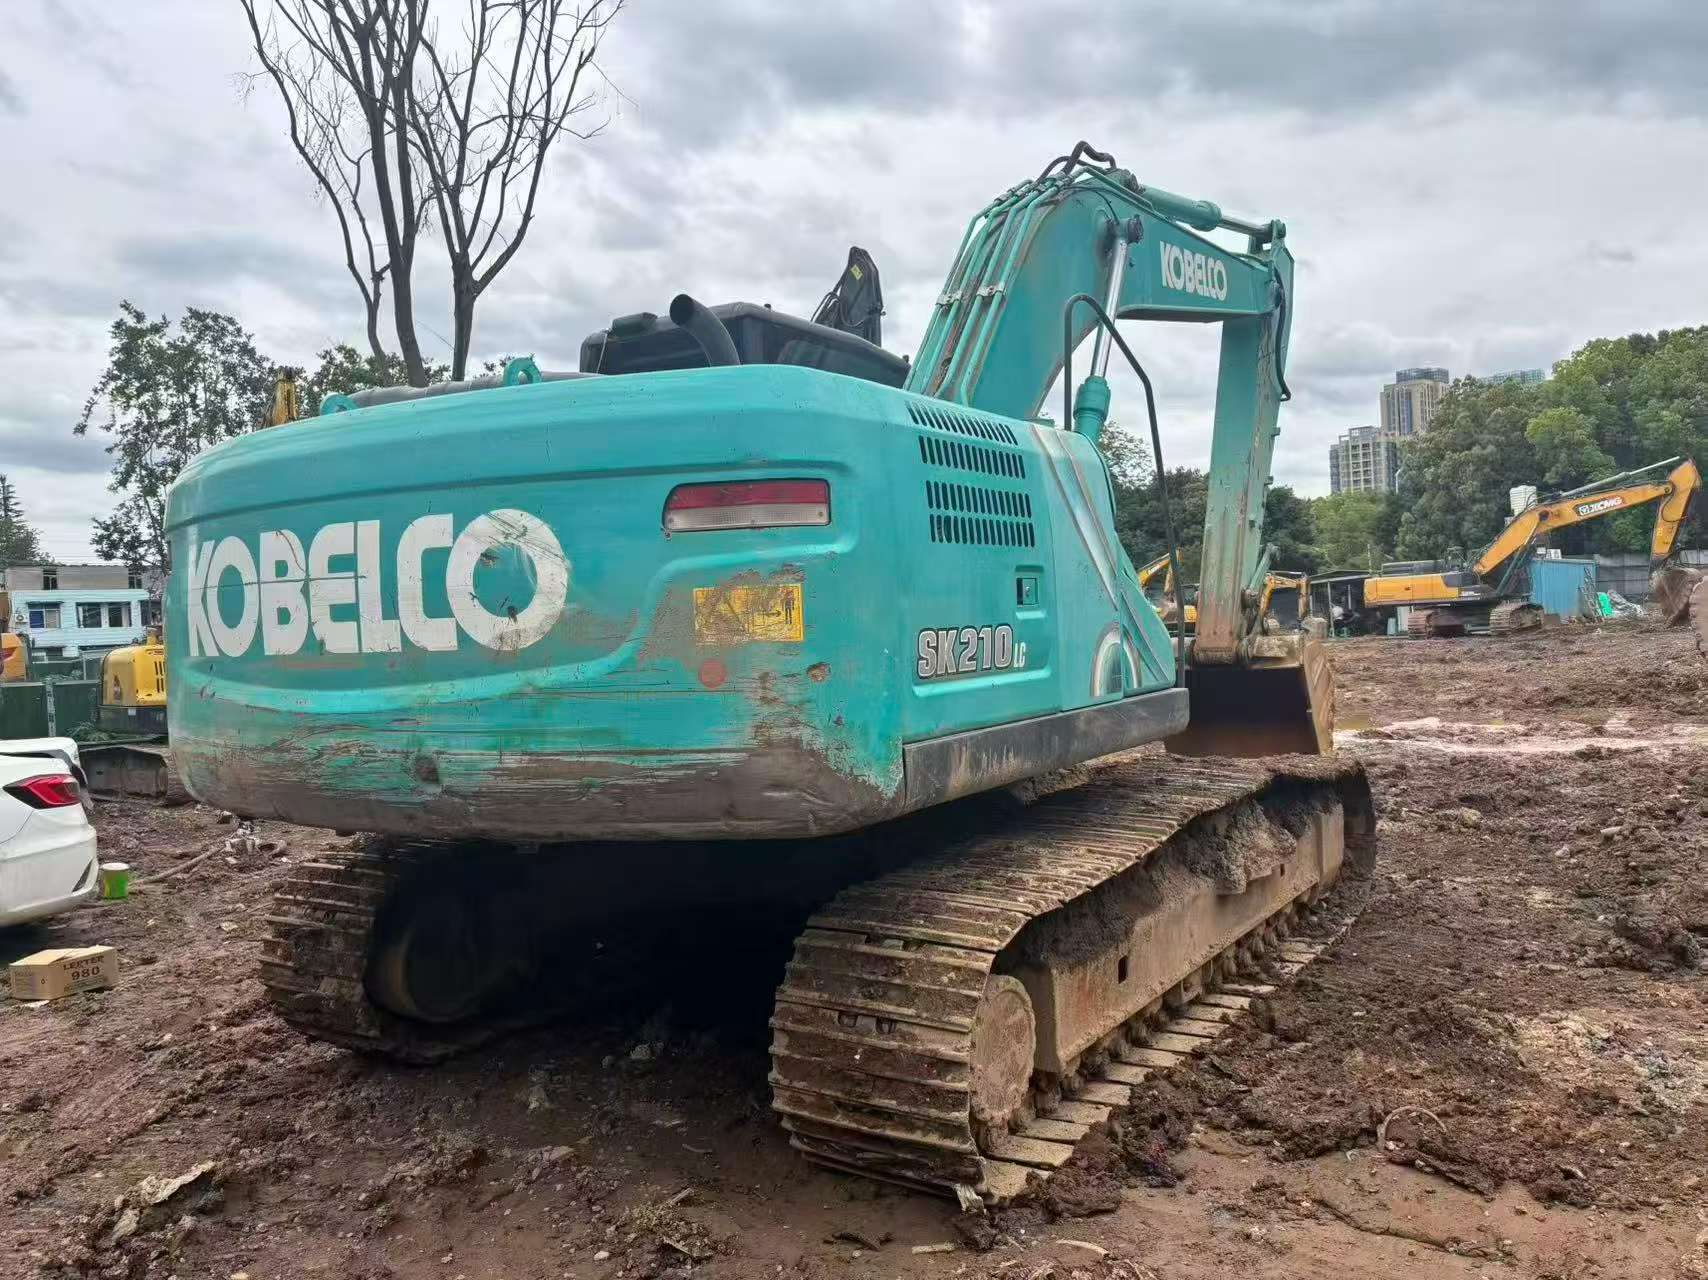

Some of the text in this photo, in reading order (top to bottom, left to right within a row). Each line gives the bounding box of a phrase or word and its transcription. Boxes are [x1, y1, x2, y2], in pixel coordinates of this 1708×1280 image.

[1160, 240, 1228, 301] KOBELCO
[187, 508, 568, 657] KOBELCO
[917, 623, 1014, 679] SK210
[71, 966, 100, 981] 980
